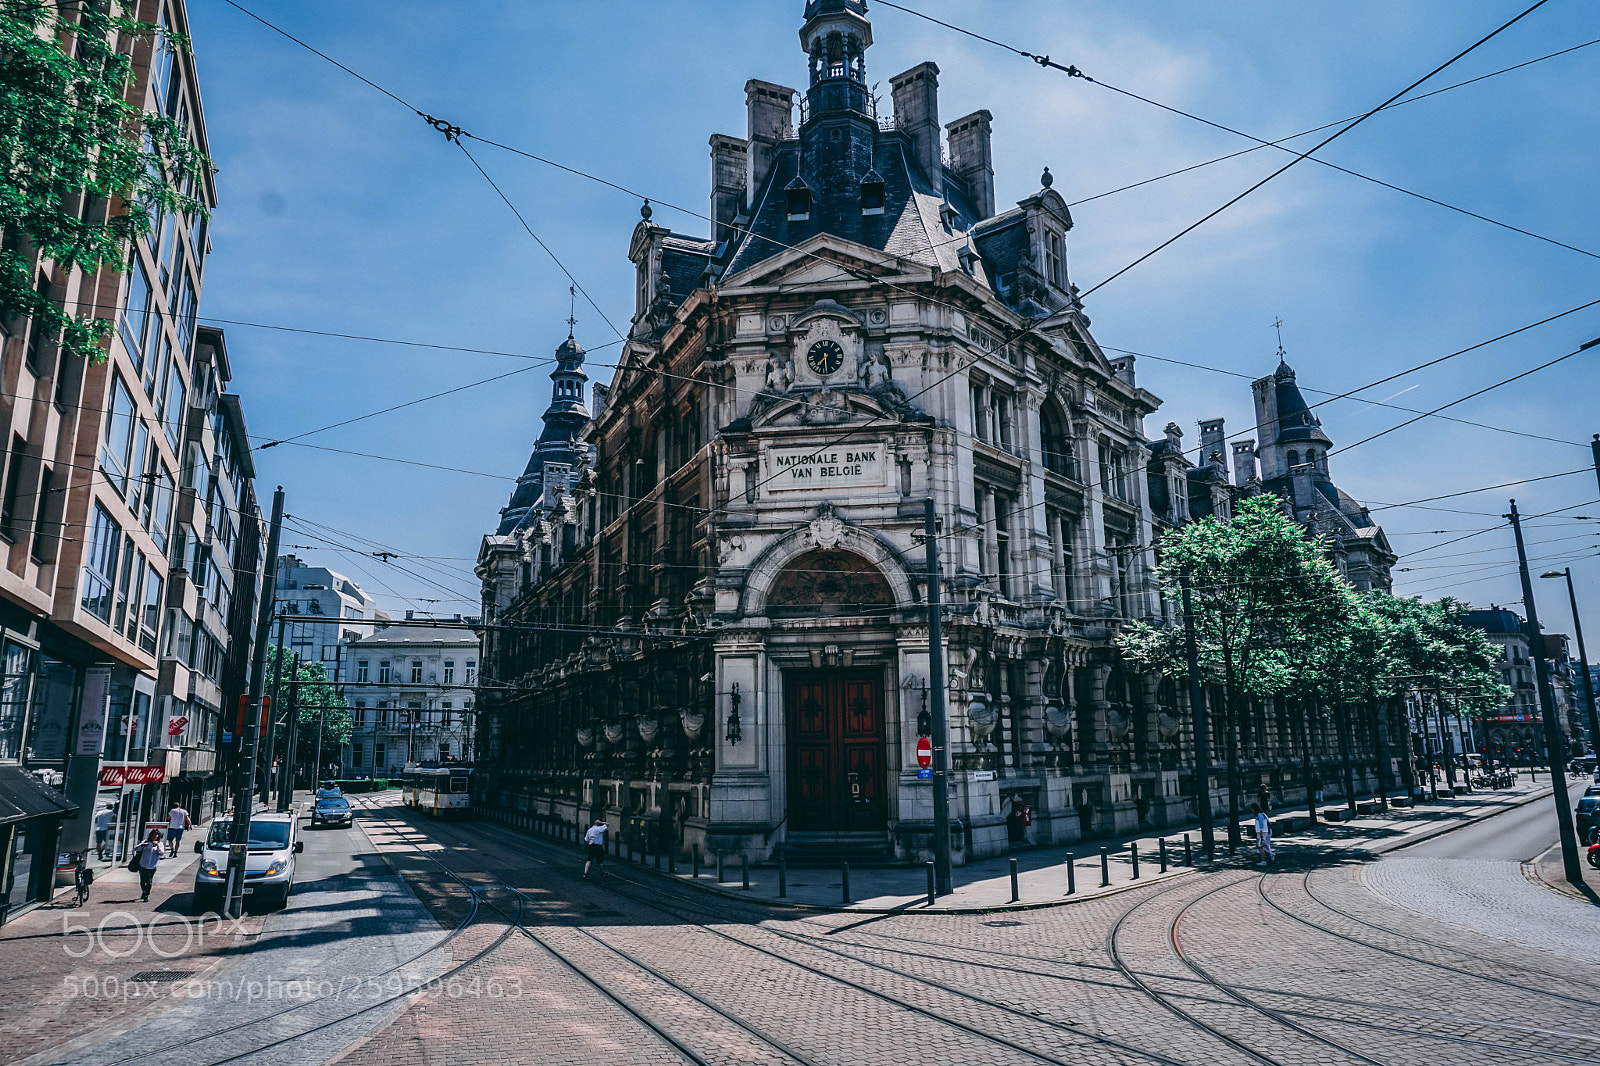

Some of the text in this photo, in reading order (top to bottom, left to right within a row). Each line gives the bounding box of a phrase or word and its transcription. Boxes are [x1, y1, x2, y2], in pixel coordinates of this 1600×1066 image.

[776, 451, 876, 466] NATIONALE BANK
[791, 463, 862, 478] VAN BELGIË
[102, 768, 123, 783] illy
[127, 768, 146, 782] illy
[147, 767, 163, 780] illy
